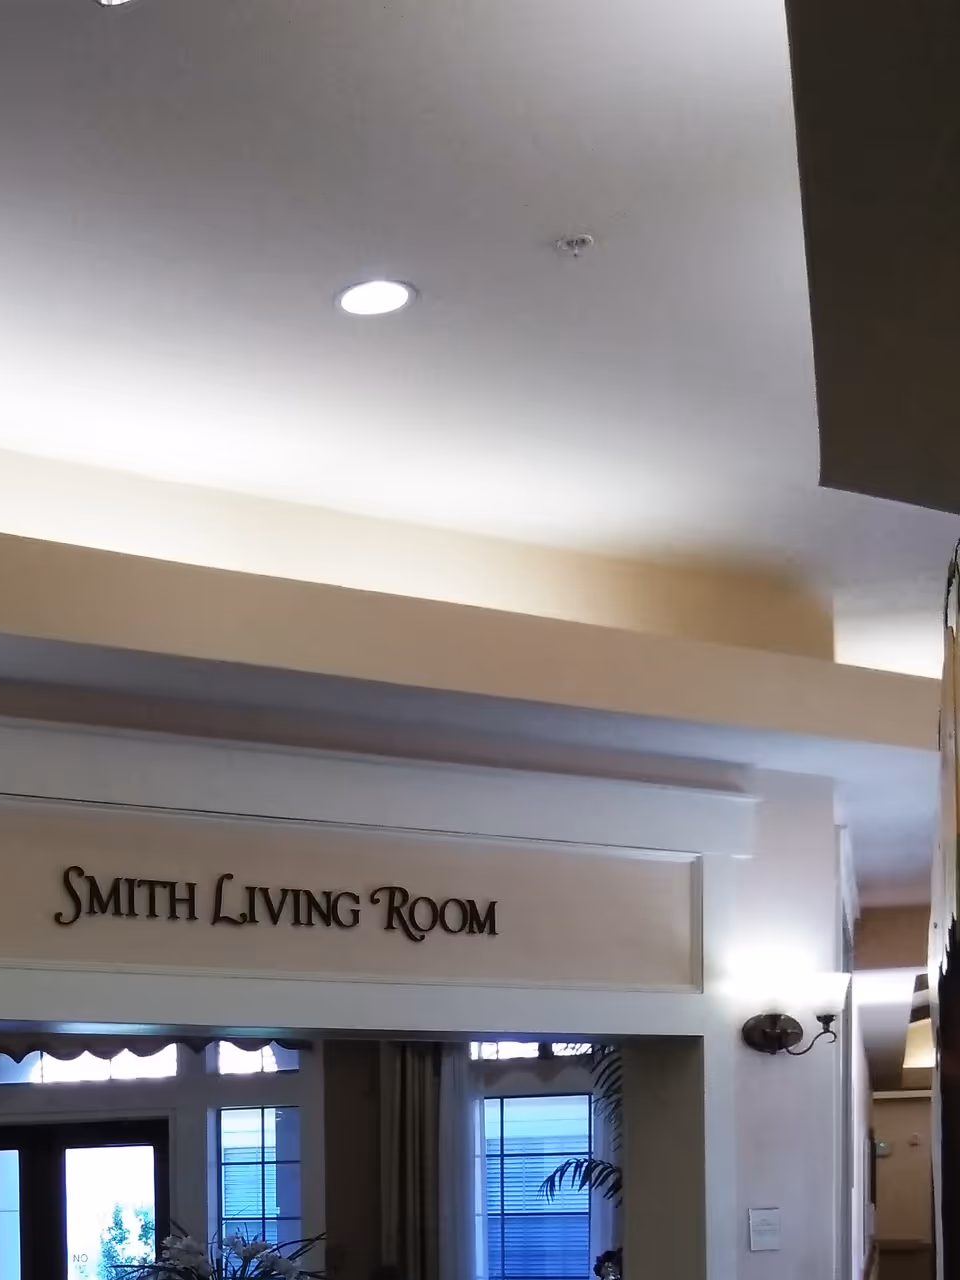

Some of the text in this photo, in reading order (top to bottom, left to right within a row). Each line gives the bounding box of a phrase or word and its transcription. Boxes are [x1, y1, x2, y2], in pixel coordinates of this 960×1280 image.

[53, 865, 499, 943] SMITH LIVING ROOM
